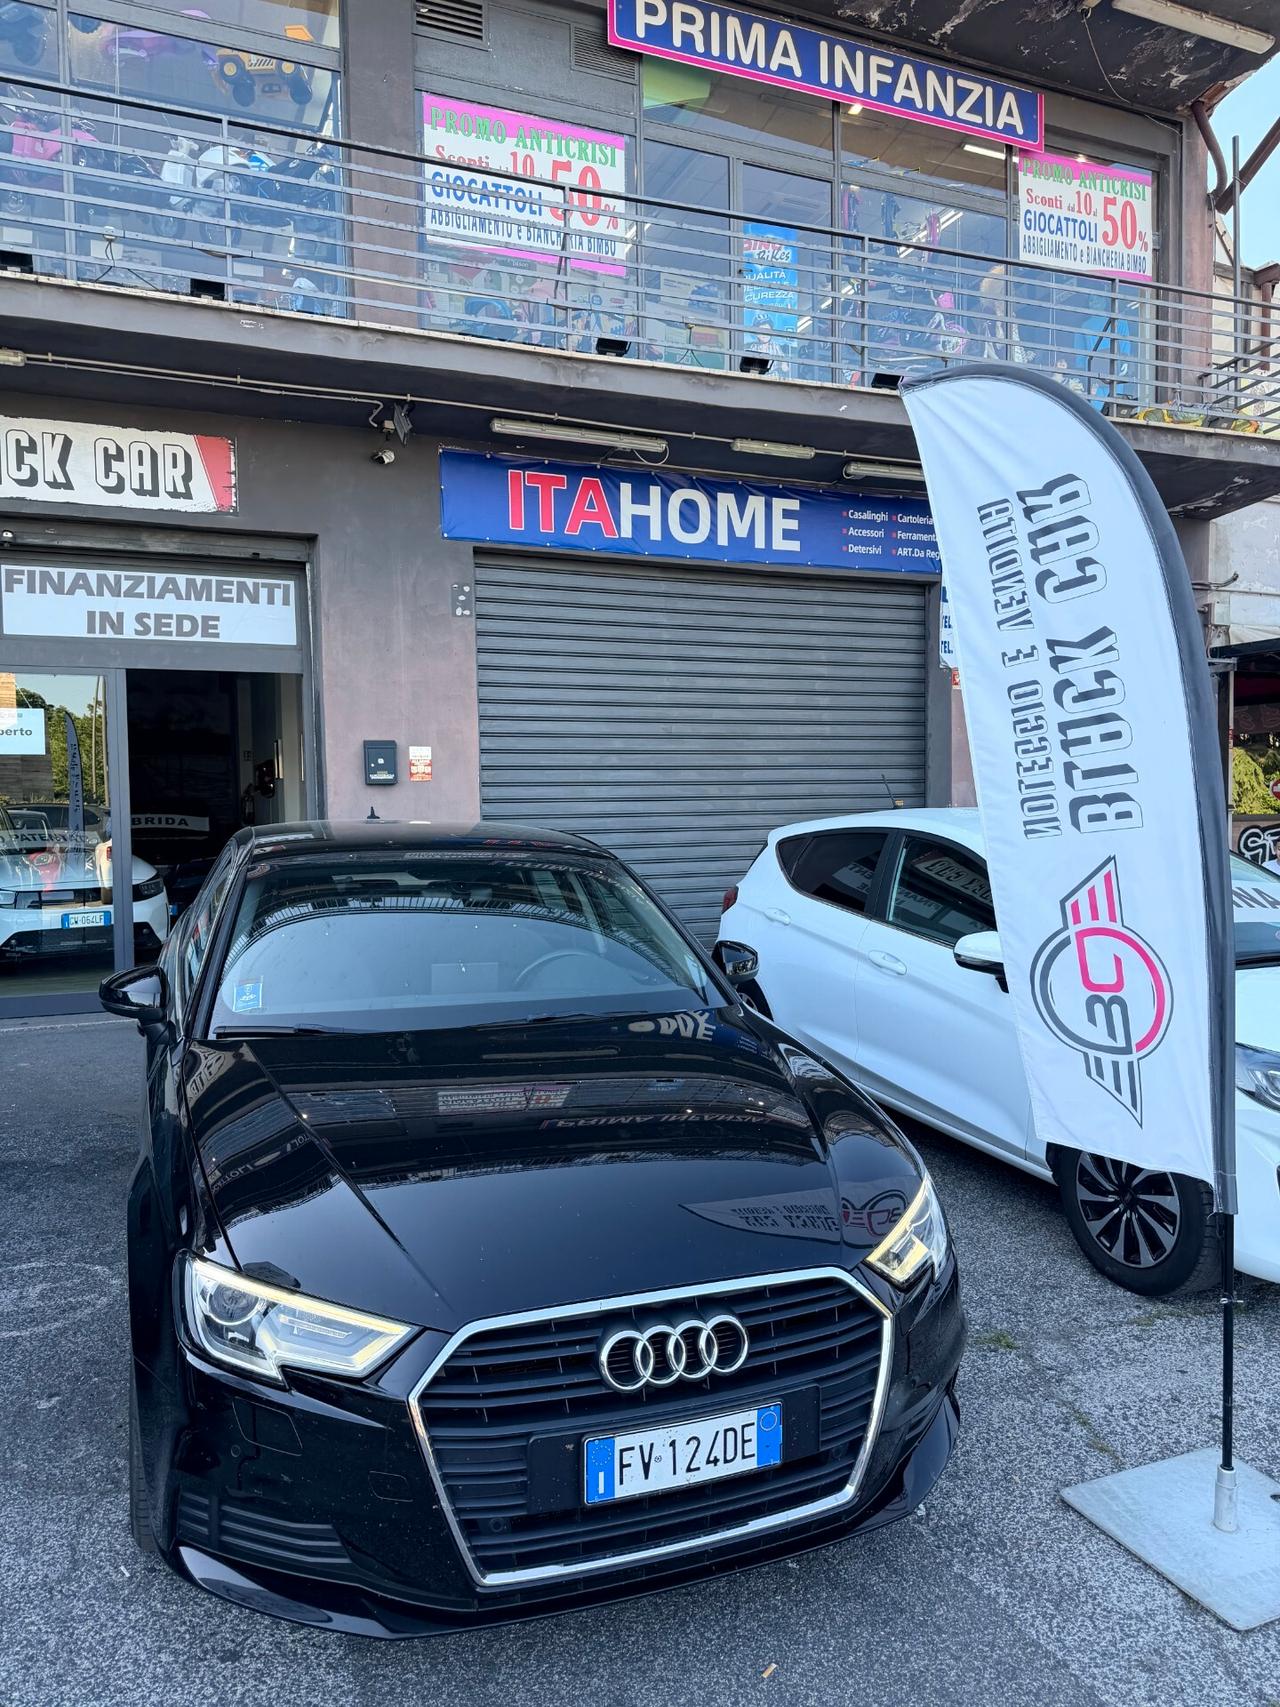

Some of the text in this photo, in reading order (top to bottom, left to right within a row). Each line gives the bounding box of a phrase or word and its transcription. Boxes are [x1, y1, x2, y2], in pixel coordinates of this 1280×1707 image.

[635, 0, 1024, 135] PRIMA INFANZIA
[430, 107, 617, 168] PROMO ANTICRISI
[431, 171, 543, 217] GIOCATTOLI
[1022, 157, 1147, 202] PROMO ANTICRISI
[1026, 188, 1063, 210] Sconti
[1075, 190, 1092, 217] 10
[431, 202, 513, 239] ABBIGLIAMENTO
[526, 219, 583, 252] BIANCHRIA
[587, 235, 617, 257] BIMBO
[1023, 208, 1098, 243] GIOCATTOLI
[1022, 234, 1078, 263] ABBIGLIAMENTO
[1086, 245, 1125, 270] BIANCHERIA
[1126, 255, 1147, 274] BIMBO
[0, 428, 193, 500] CK CAR
[507, 469, 801, 552] ITAHOME
[848, 509, 934, 525] Casalinghi Cartoleria
[848, 527, 938, 542] Accessori Ferrament
[848, 543, 882, 555] Detersivi
[4, 568, 291, 606] FINANZIAMENTI
[86, 610, 221, 638] IN SEDE
